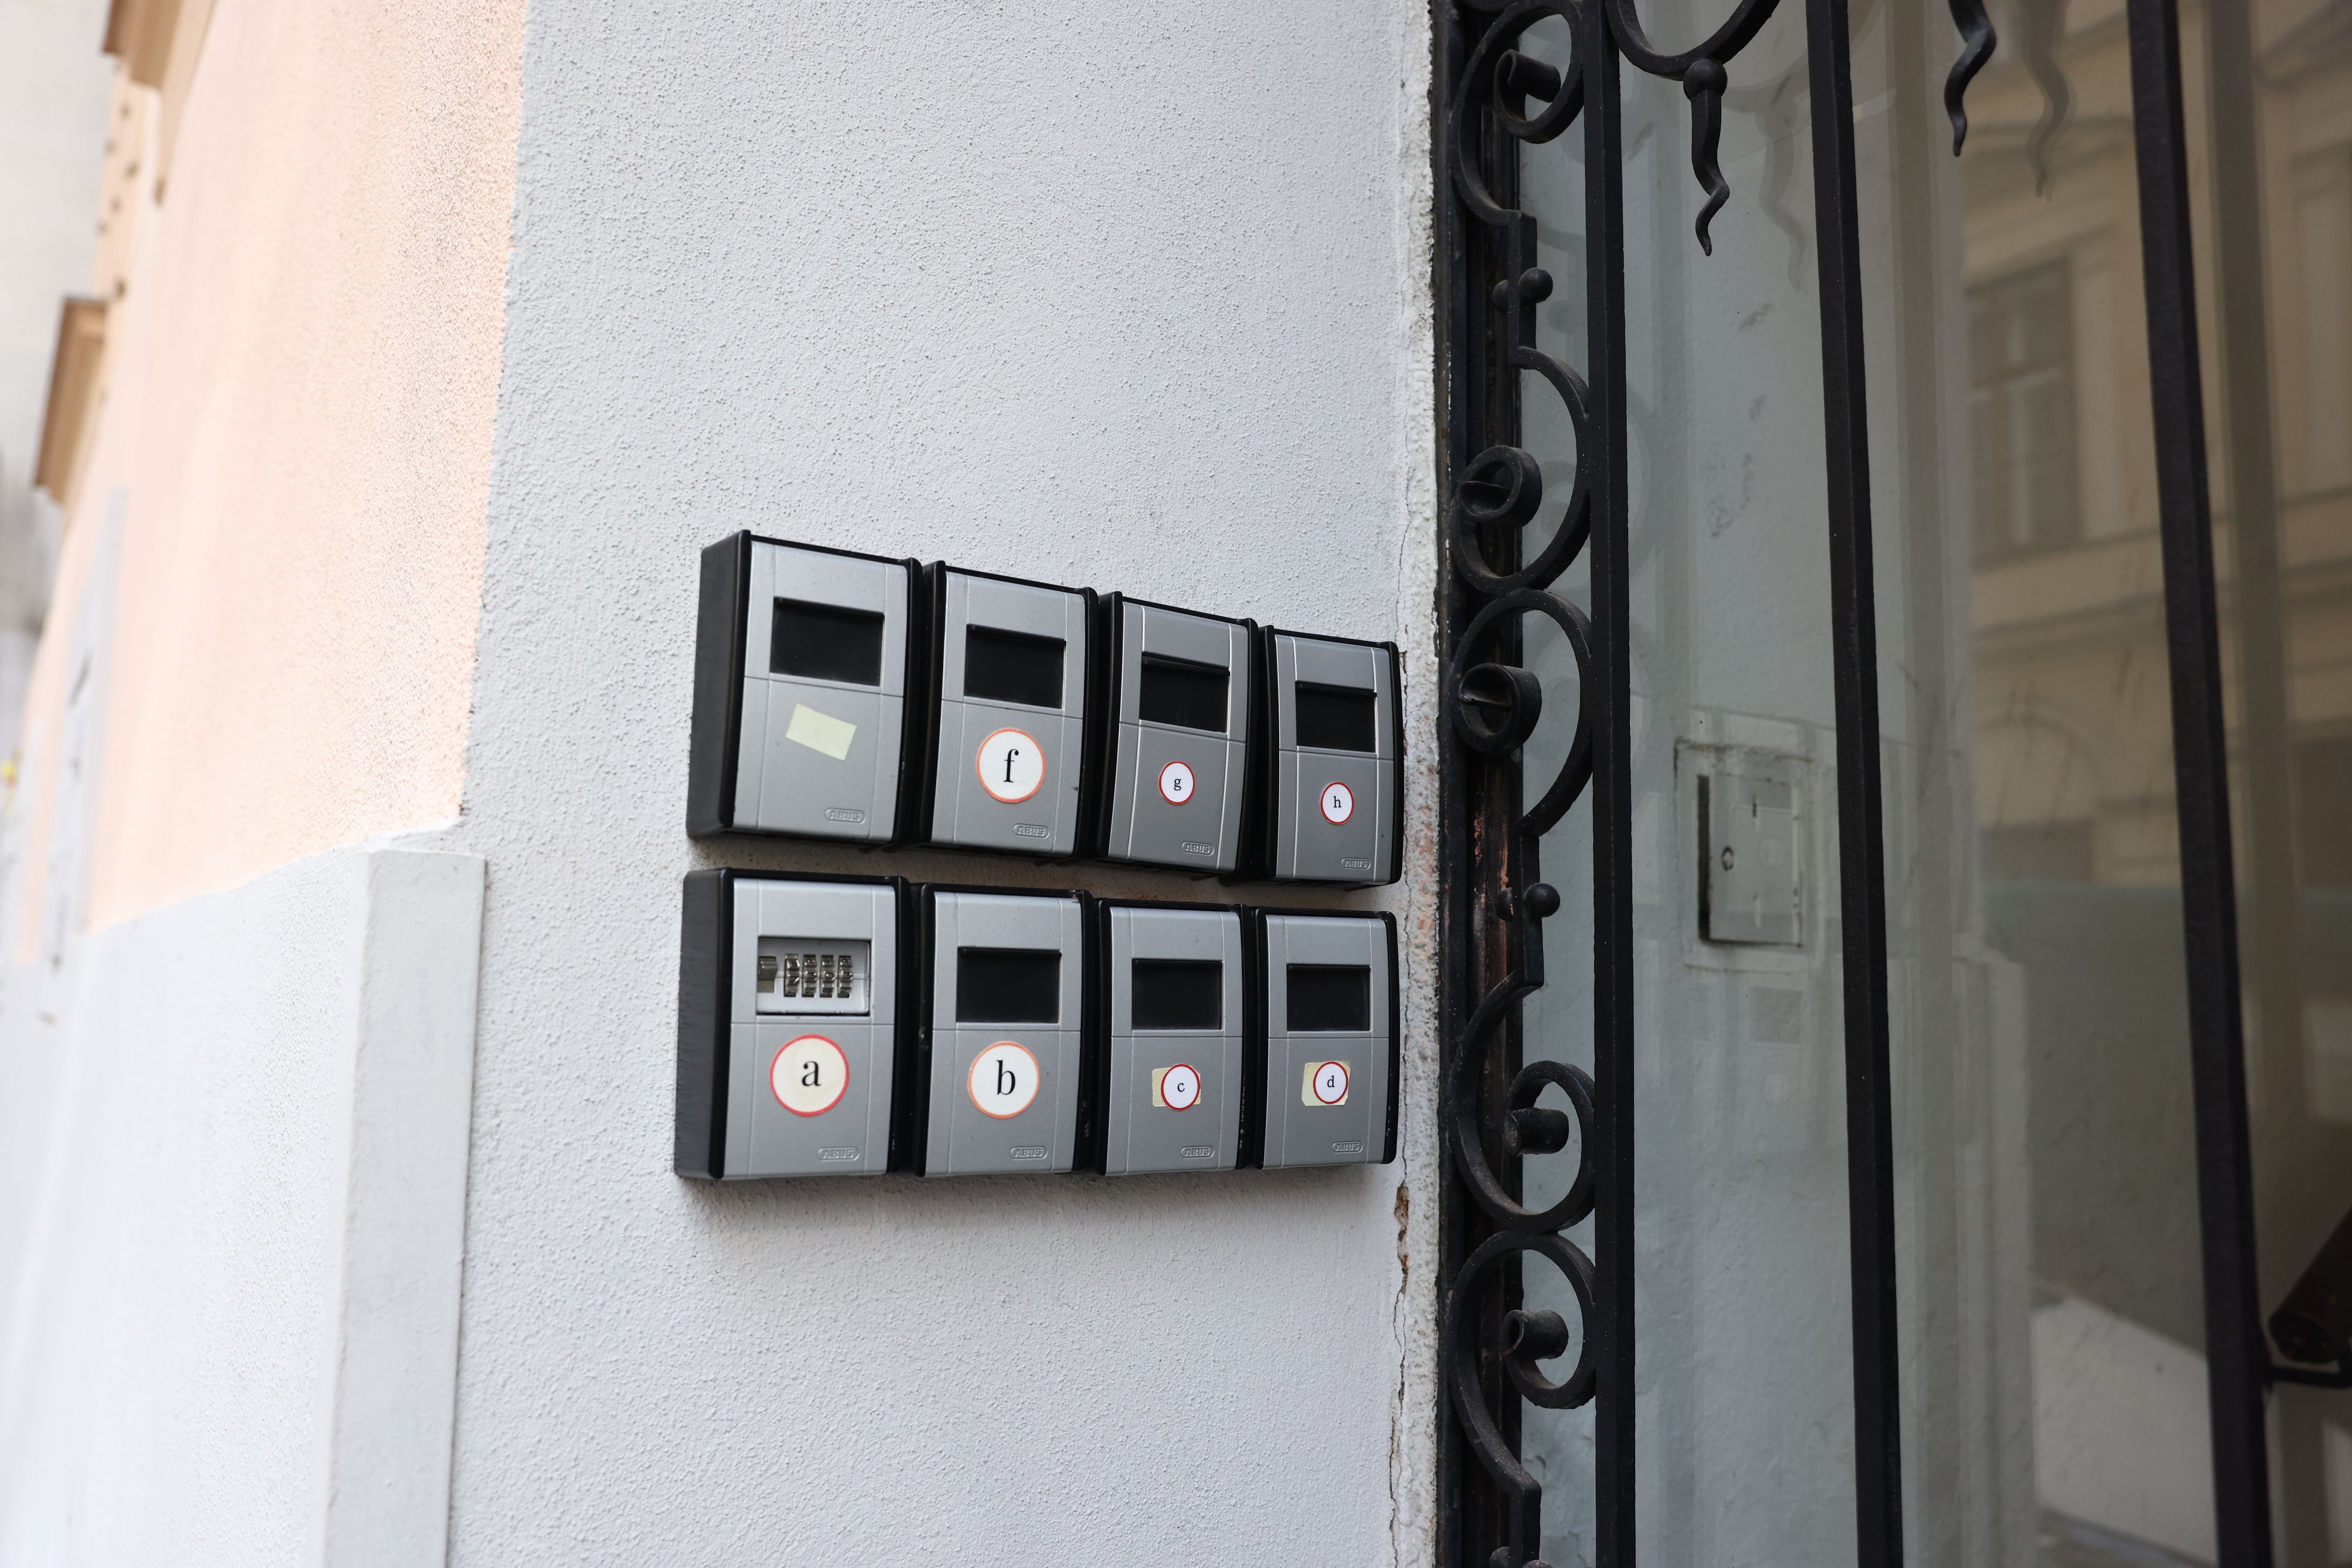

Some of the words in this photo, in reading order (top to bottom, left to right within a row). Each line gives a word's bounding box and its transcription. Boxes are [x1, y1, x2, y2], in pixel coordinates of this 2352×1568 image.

[1003, 748, 1019, 783] f
[1174, 778, 1182, 791] g
[1333, 795, 1342, 808] h
[1017, 825, 1045, 837] ABUS
[1185, 843, 1210, 854] ABUS
[1345, 860, 1367, 868] ABUS
[801, 1061, 821, 1086] a
[996, 1059, 1015, 1095] b
[1177, 1083, 1185, 1092] c
[1327, 1075, 1335, 1088] d
[1014, 1148, 1043, 1158] ABUS
[1185, 1148, 1210, 1156] ABUS
[1336, 1143, 1359, 1151] ABUS
